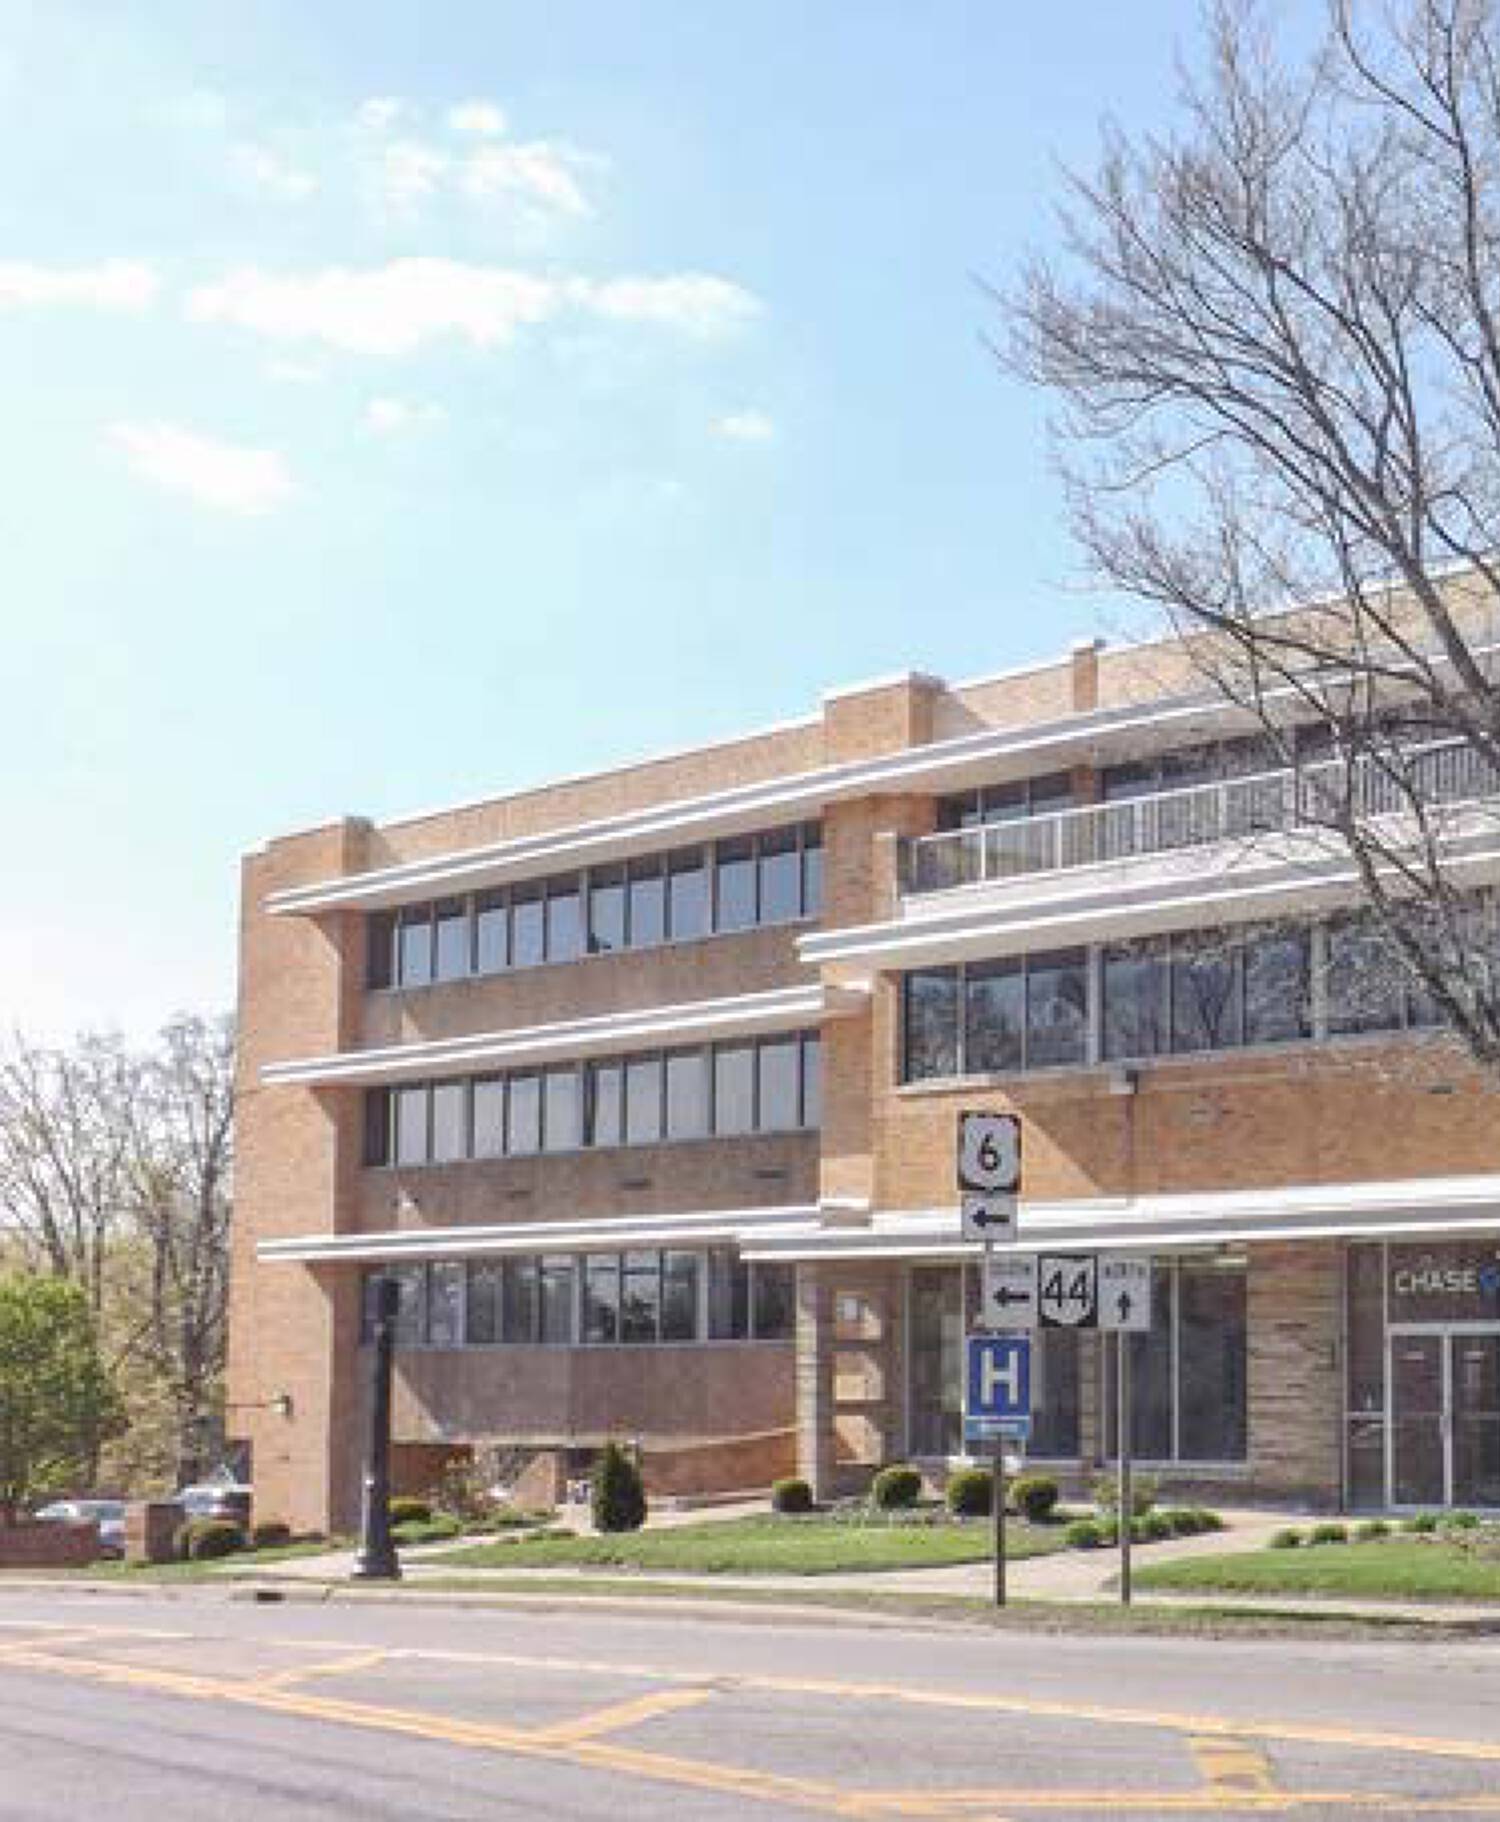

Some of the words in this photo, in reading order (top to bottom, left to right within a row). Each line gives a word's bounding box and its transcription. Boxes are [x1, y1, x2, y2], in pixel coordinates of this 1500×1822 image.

[977, 1132, 1001, 1172] 6
[1044, 1270, 1090, 1309] 44
[1394, 1269, 1477, 1292] CHASE
[980, 1350, 1019, 1405] H
